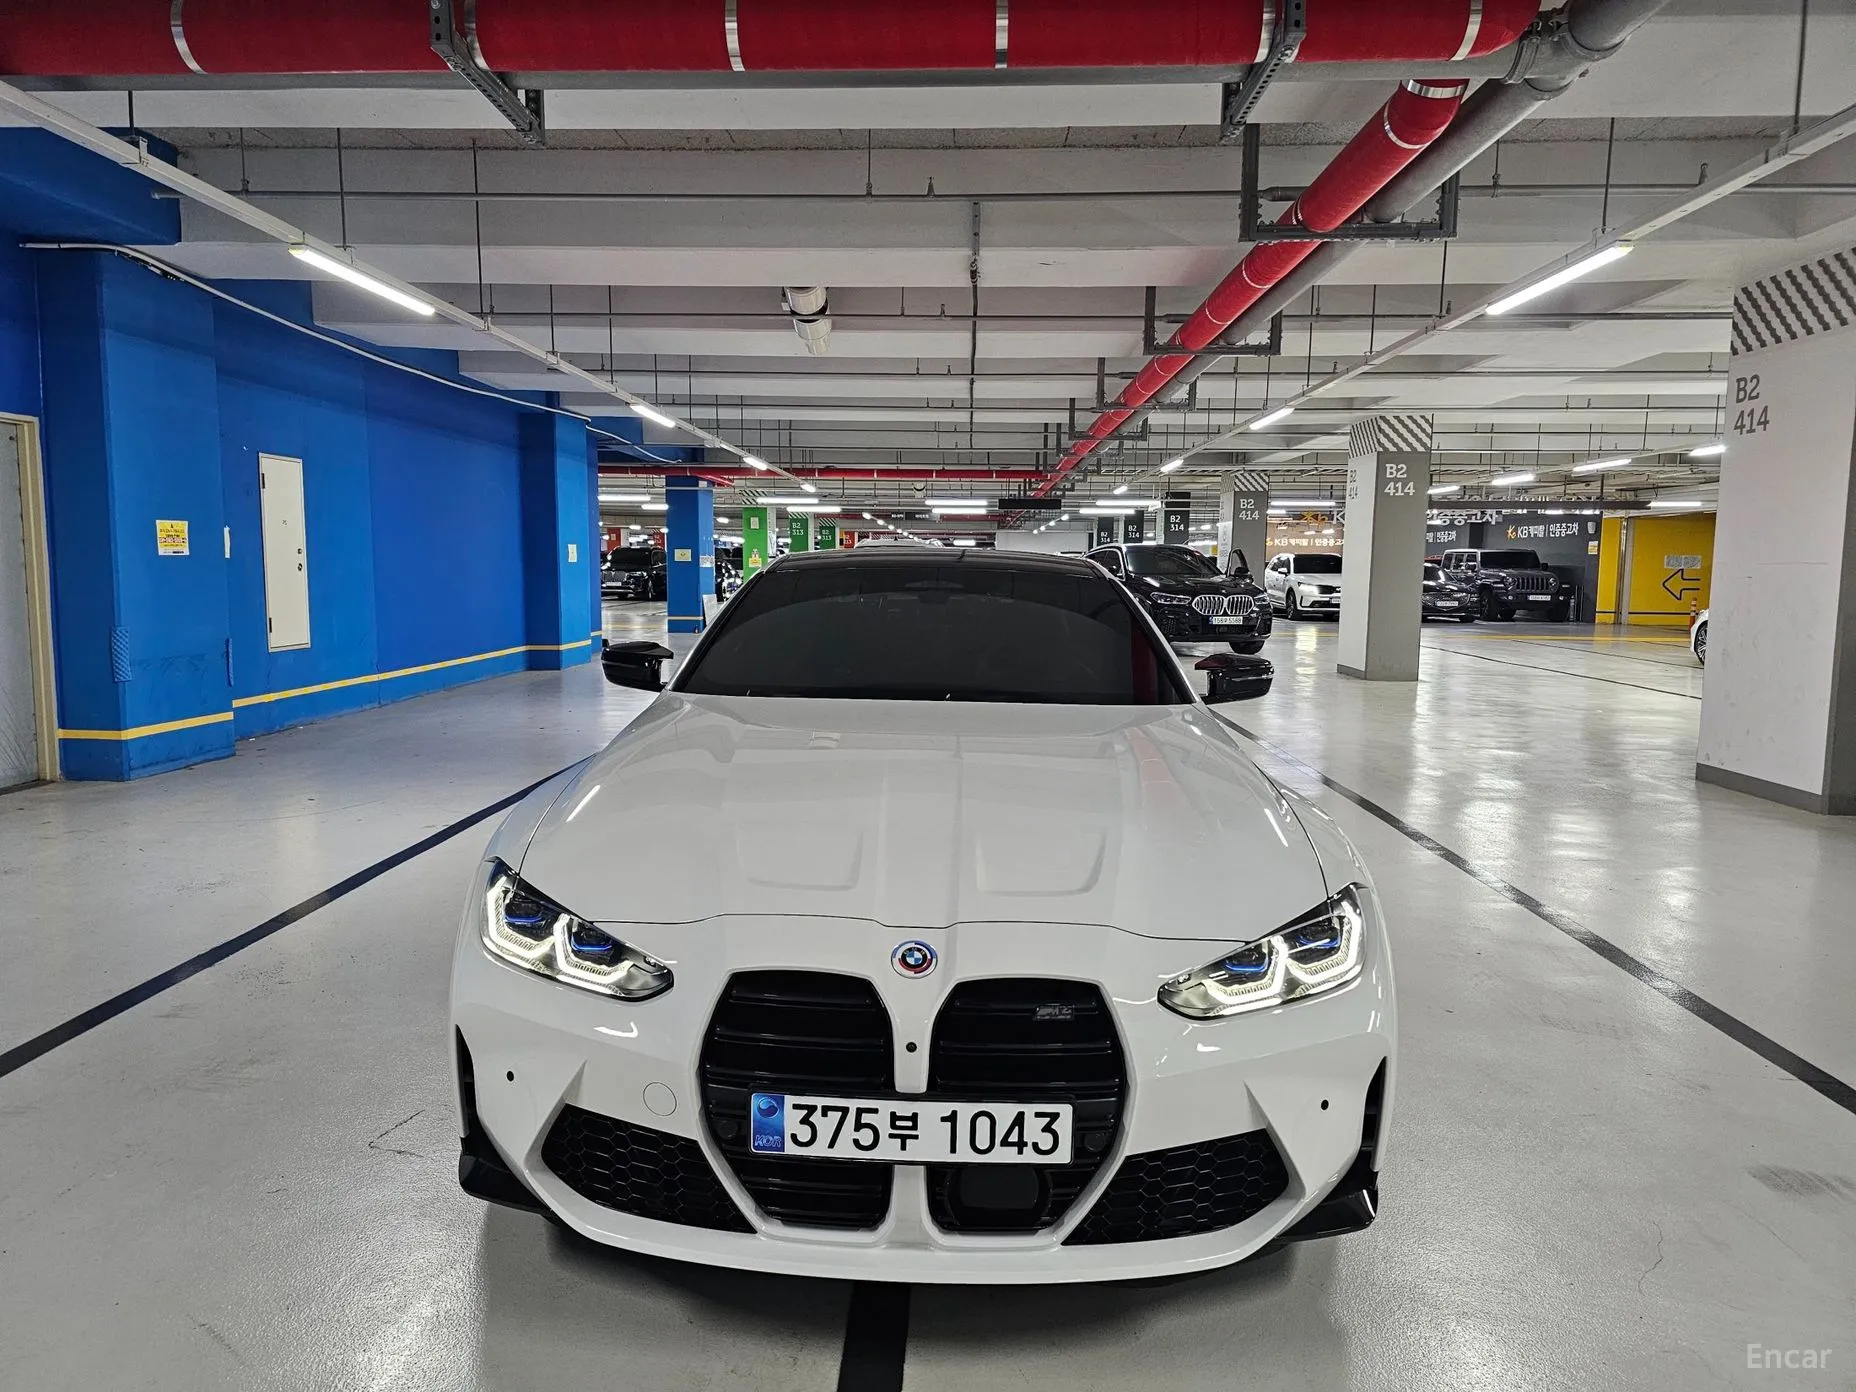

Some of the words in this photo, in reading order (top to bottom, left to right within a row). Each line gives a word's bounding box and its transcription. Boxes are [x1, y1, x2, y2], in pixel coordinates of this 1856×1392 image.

[1735, 374, 1760, 404] B2
[1733, 405, 1770, 436] 414
[1385, 463, 1407, 478] B2
[1383, 481, 1416, 496] 414
[1240, 499, 1255, 509] B2
[1170, 515, 1181, 523] B2
[1238, 510, 1260, 520] 414
[1549, 522, 1579, 537] 인증중고차
[790, 1103, 919, 1151] 375부
[940, 1109, 1061, 1156] 1043
[754, 1134, 782, 1148] KOR
